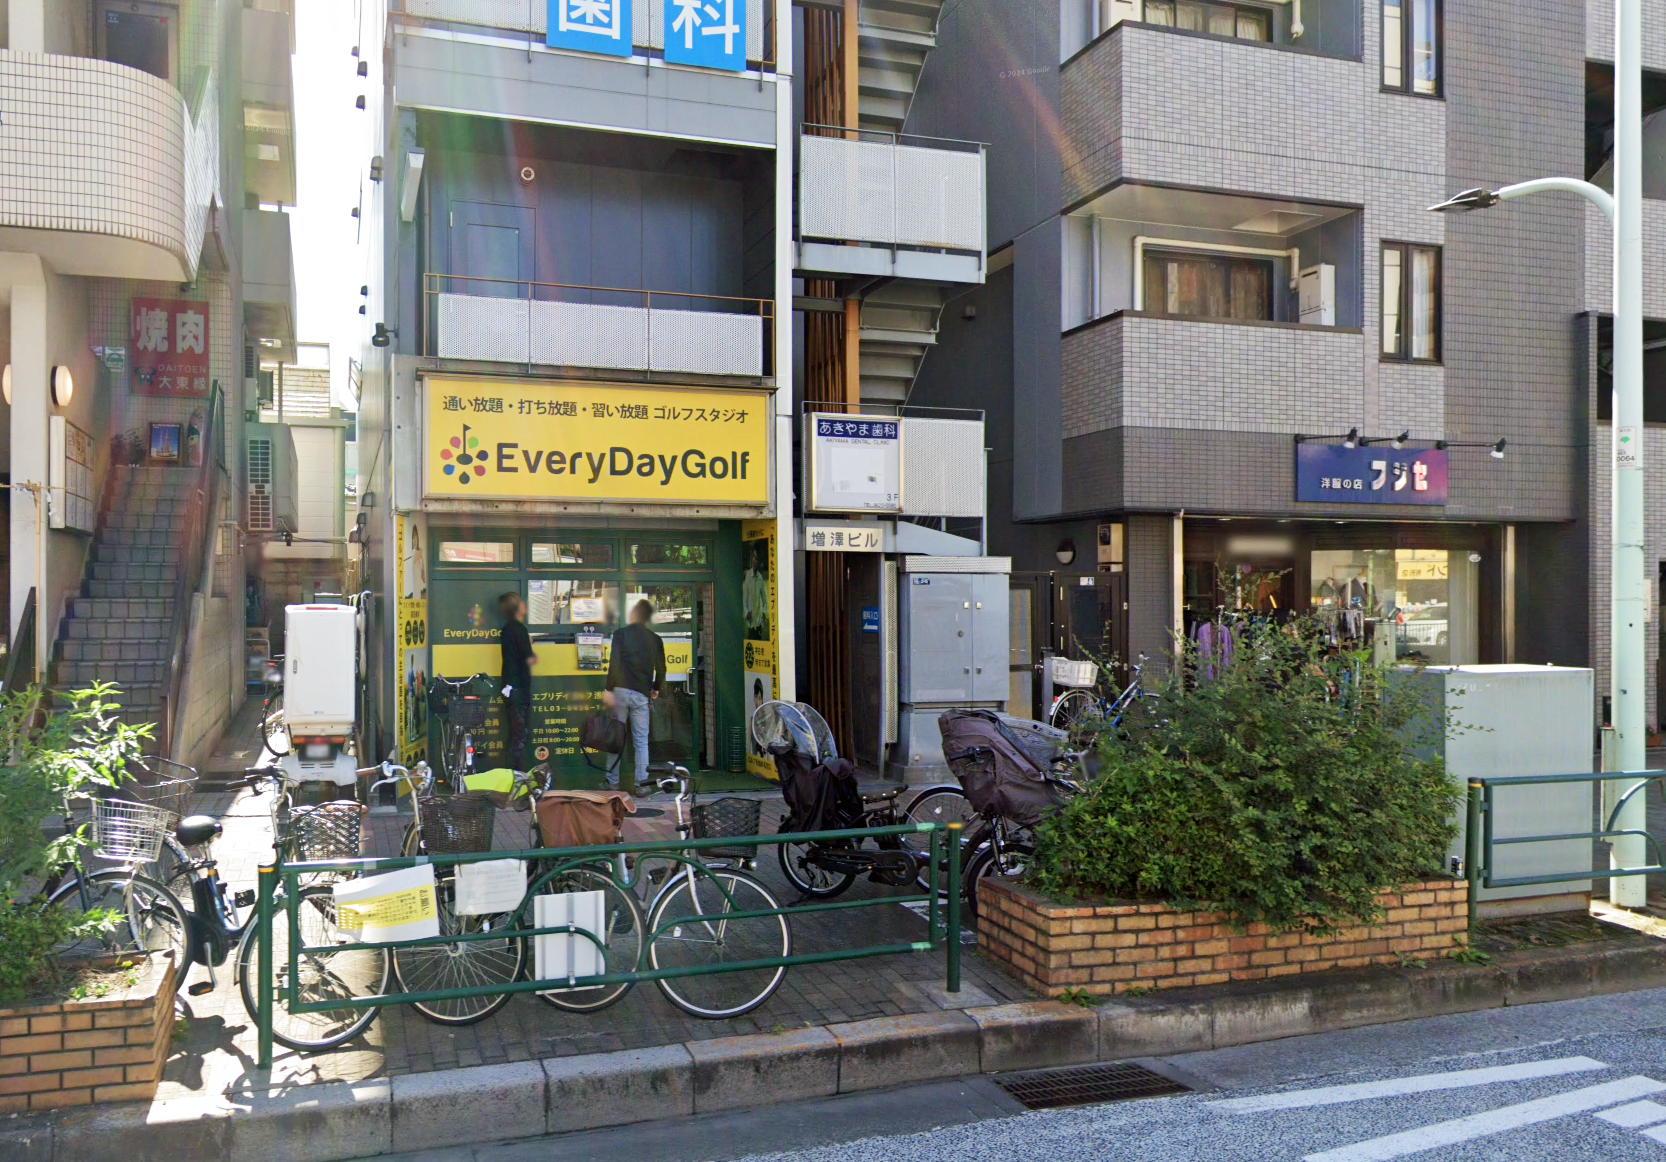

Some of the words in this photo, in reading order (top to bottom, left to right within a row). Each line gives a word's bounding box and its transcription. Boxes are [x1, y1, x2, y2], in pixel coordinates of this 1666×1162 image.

[136, 307, 206, 355] 焼肉
[158, 363, 206, 374] DAITOEN
[442, 394, 649, 422] 通い放題・打ち放題・習い放題
[653, 406, 749, 424] ゴルフスタジオ
[819, 421, 896, 438] あきやま歯科
[496, 442, 750, 486] EveryDayGolf
[1320, 477, 1363, 490] 洋服の店
[1371, 460, 1428, 491] フジセ
[810, 531, 879, 549] 増澤ビル
[443, 628, 502, 640] EveryDayGo
[419, 889, 430, 917] お願い
